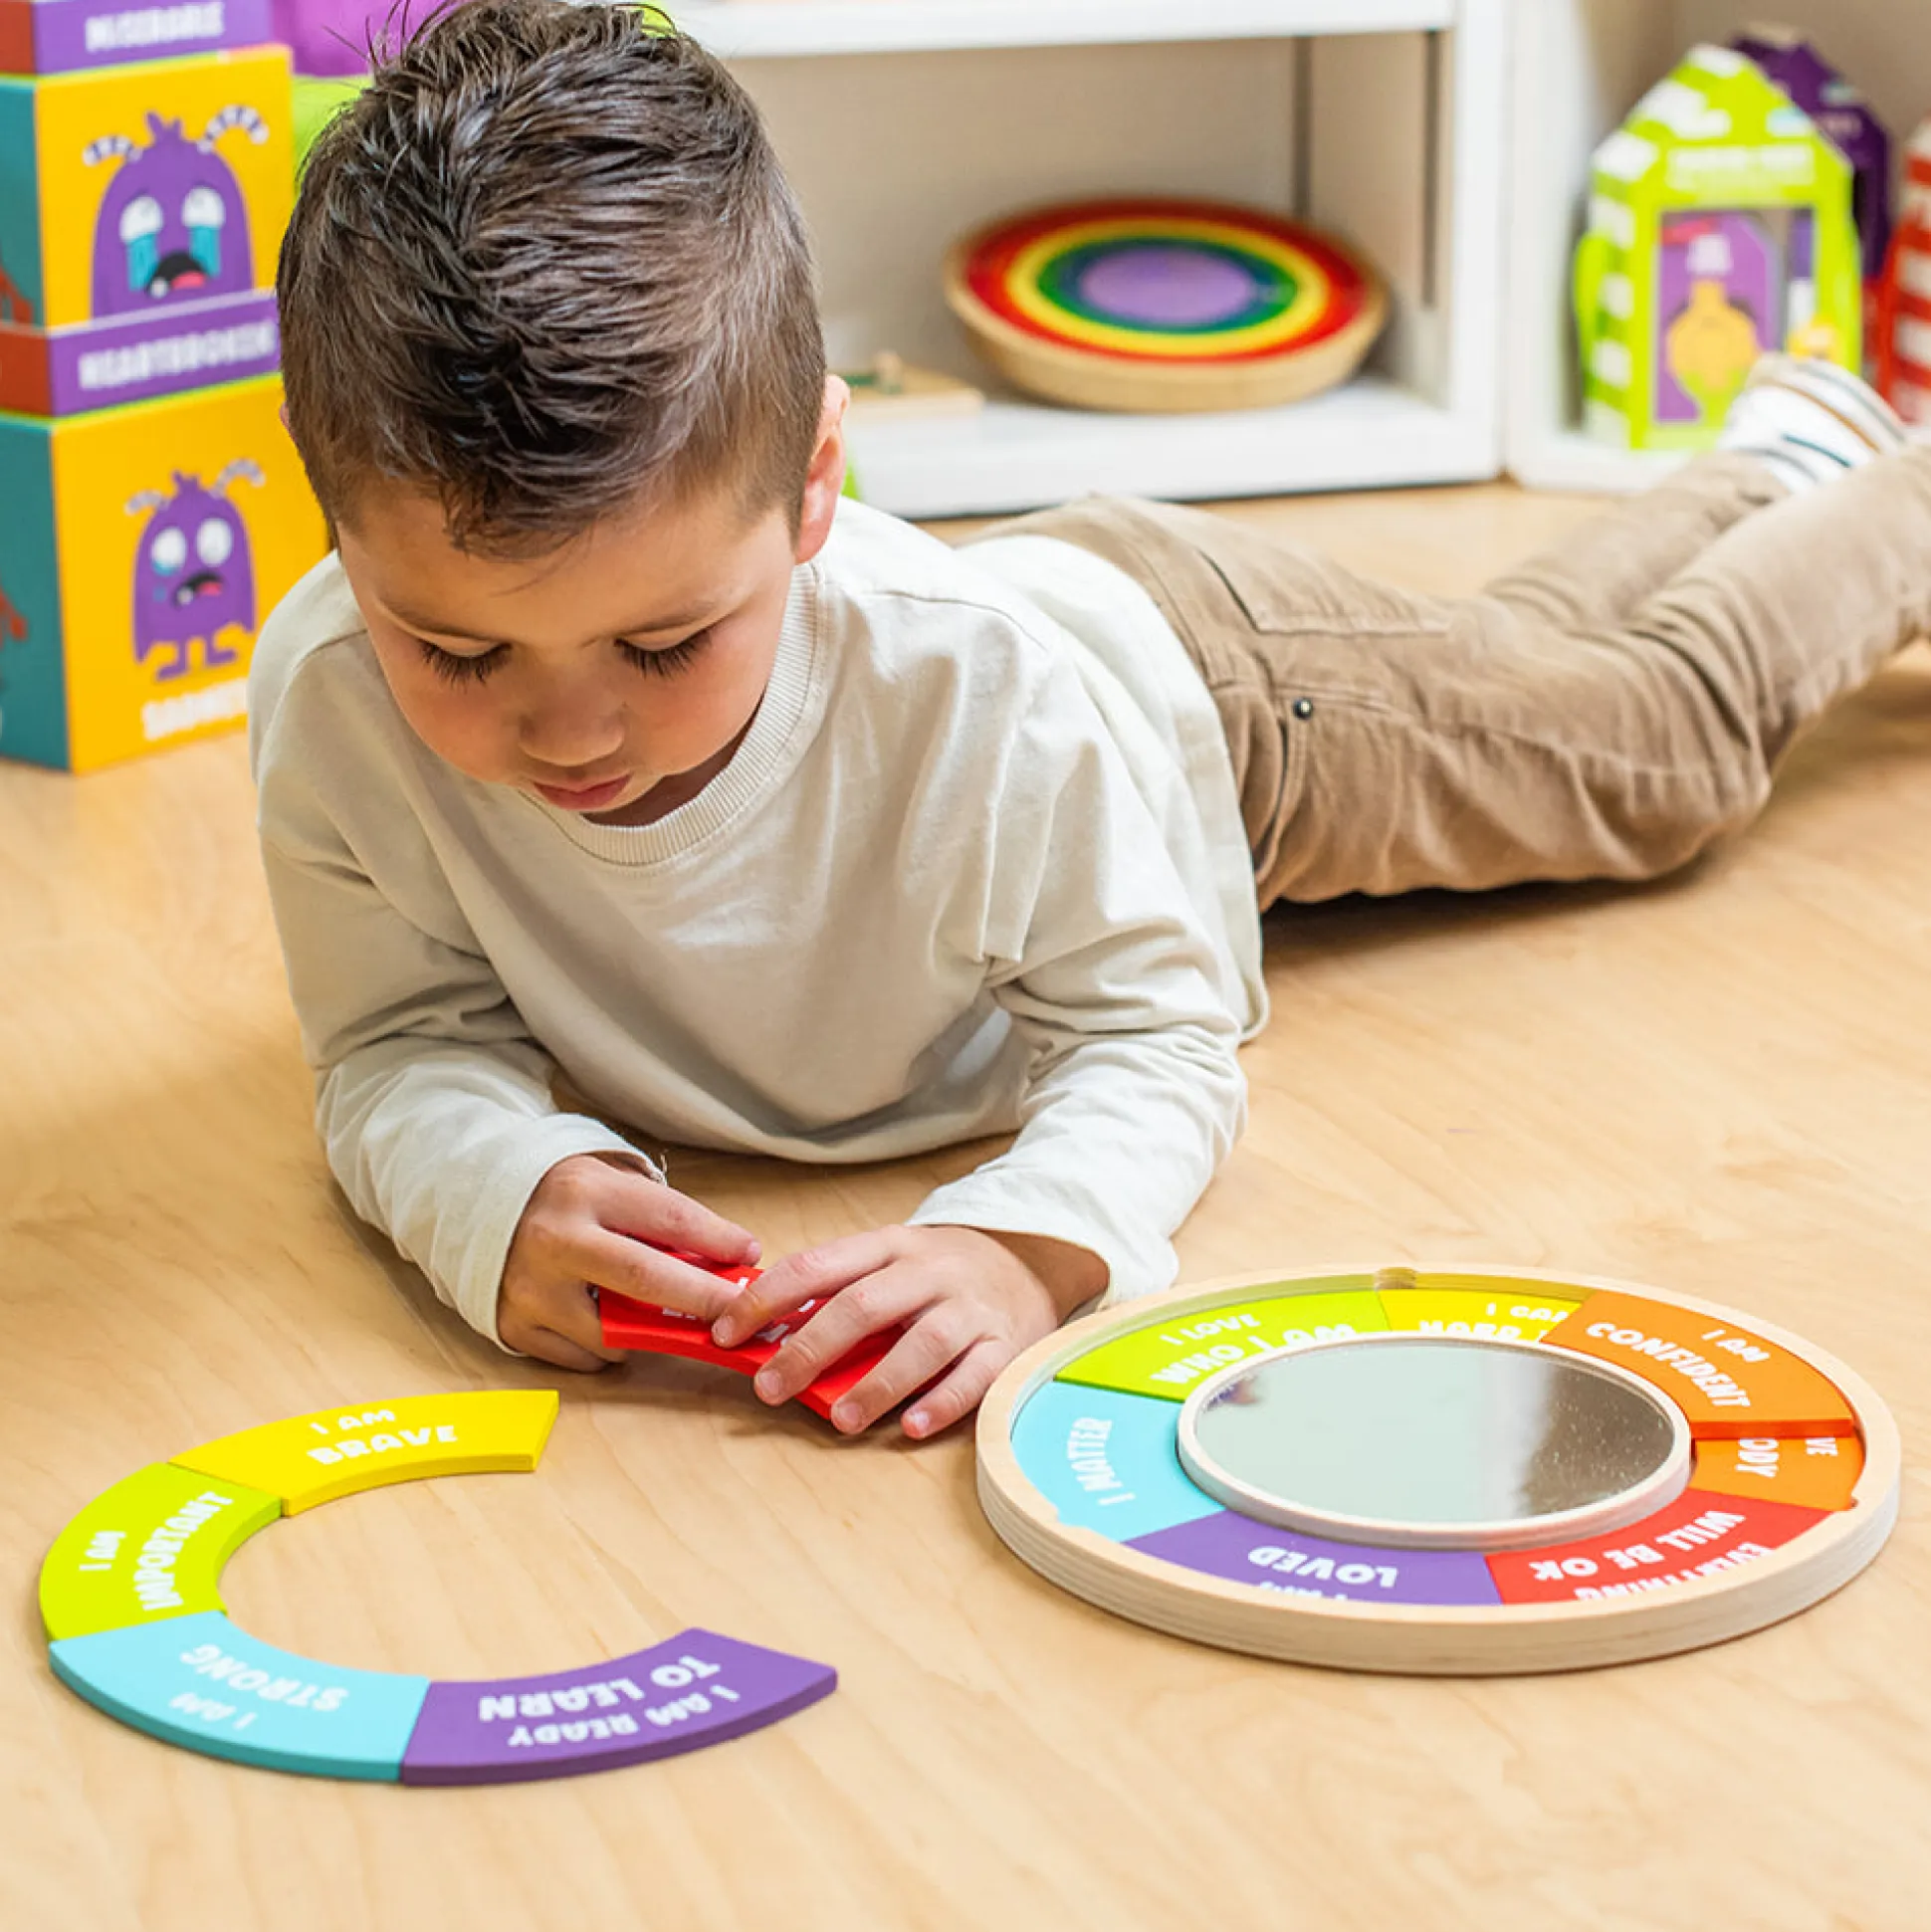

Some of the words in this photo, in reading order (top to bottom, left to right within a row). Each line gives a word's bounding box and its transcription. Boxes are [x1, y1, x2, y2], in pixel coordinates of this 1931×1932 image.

[1485, 1302, 1496, 1317] I
[1160, 1334, 1183, 1346] I
[1180, 1314, 1261, 1340] LOVE
[1701, 1329, 1726, 1341] I
[1715, 1338, 1771, 1363] AM
[1150, 1345, 1244, 1385] WHO
[1247, 1335, 1276, 1353] I
[1586, 1322, 1752, 1407] CONFIDENT
[310, 1421, 329, 1434] I
[338, 1408, 396, 1430] AM
[307, 1424, 458, 1464] BRAVE
[1067, 1416, 1123, 1491] MATTER
[1735, 1437, 1779, 1478] ODY
[1098, 1492, 1136, 1505] I
[86, 1531, 126, 1560] AM
[1654, 1510, 1746, 1552] WILL
[133, 1491, 233, 1610] IMPORTANT
[1604, 1544, 1664, 1570] BE
[79, 1563, 112, 1572] I
[1248, 1546, 1397, 1589] LOVED
[1529, 1558, 1599, 1581] OK
[180, 1644, 349, 1712] STRONG
[650, 1655, 721, 1687] TO
[169, 1692, 237, 1722] AM
[479, 1677, 645, 1721] LEARN
[645, 1693, 712, 1726] AM
[710, 1684, 741, 1702] I
[234, 1712, 257, 1731] I
[508, 1713, 639, 1747] READY
